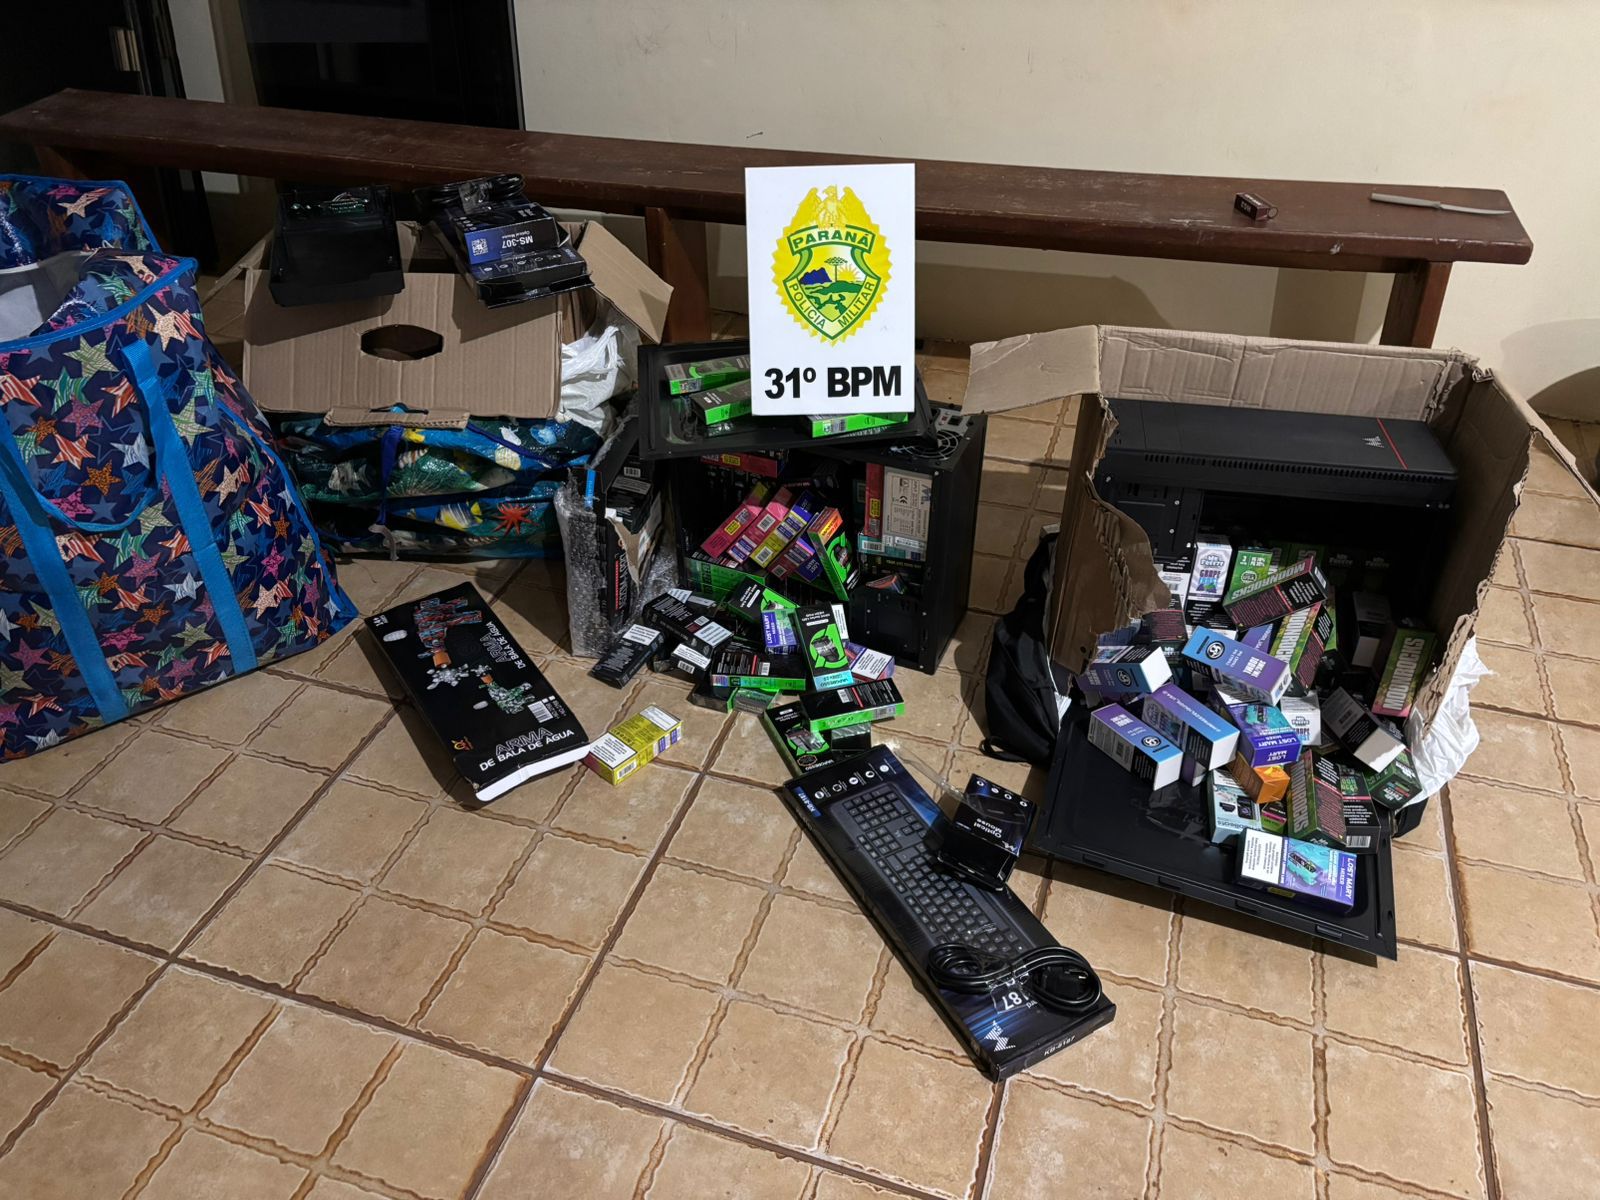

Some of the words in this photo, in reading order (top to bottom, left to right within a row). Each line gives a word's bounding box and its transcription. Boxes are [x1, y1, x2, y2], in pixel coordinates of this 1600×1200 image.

[501, 235, 534, 249] MS-307
[792, 230, 870, 250] PARANÁ
[837, 281, 876, 328] MILITAR
[827, 365, 902, 398] BPM
[1382, 636, 1426, 711] MOONROCKS
[495, 727, 553, 757] ARMA
[479, 758, 496, 771] DE
[497, 746, 526, 763] BALA
[527, 741, 543, 751] DE
[973, 822, 1003, 839] Optical
[976, 817, 1003, 834] Mouse
[1345, 877, 1353, 900] MARY
